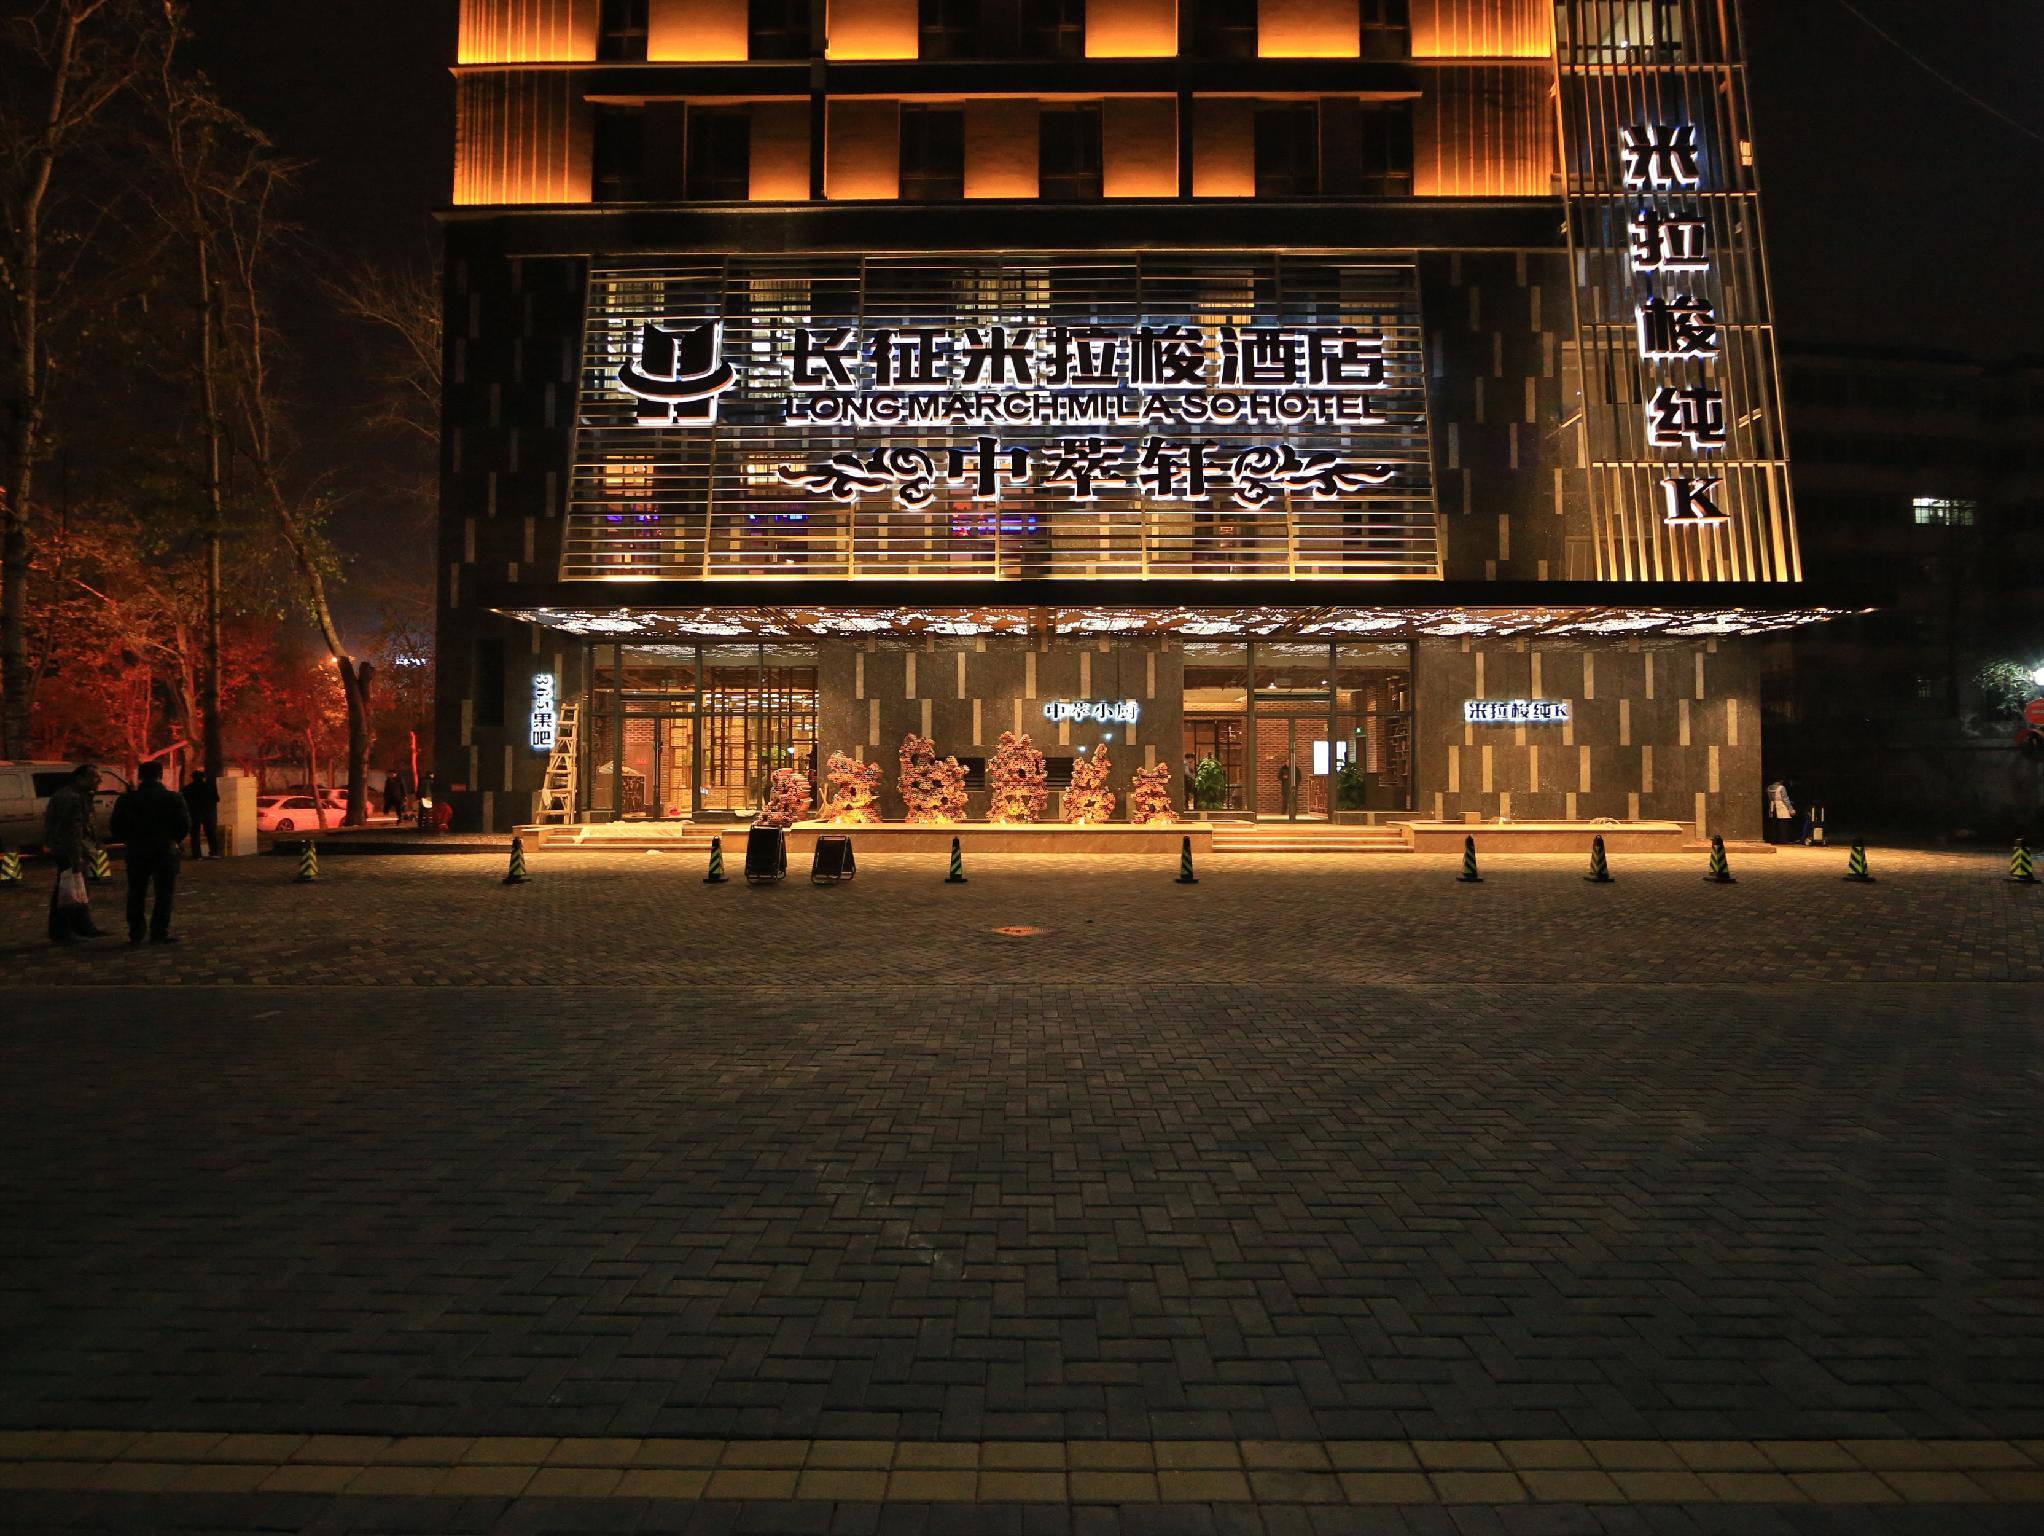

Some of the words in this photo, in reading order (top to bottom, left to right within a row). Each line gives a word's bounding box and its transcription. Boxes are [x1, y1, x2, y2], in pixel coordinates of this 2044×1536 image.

[783, 326, 1387, 387] 长征米拉梭酒店
[784, 393, 903, 423] LONG
[905, 392, 1060, 423] MARCH
[1248, 392, 1387, 424] HOTEL
[947, 436, 1223, 500] 中萃轩
[1465, 701, 1569, 720] 米拉梭纯K
